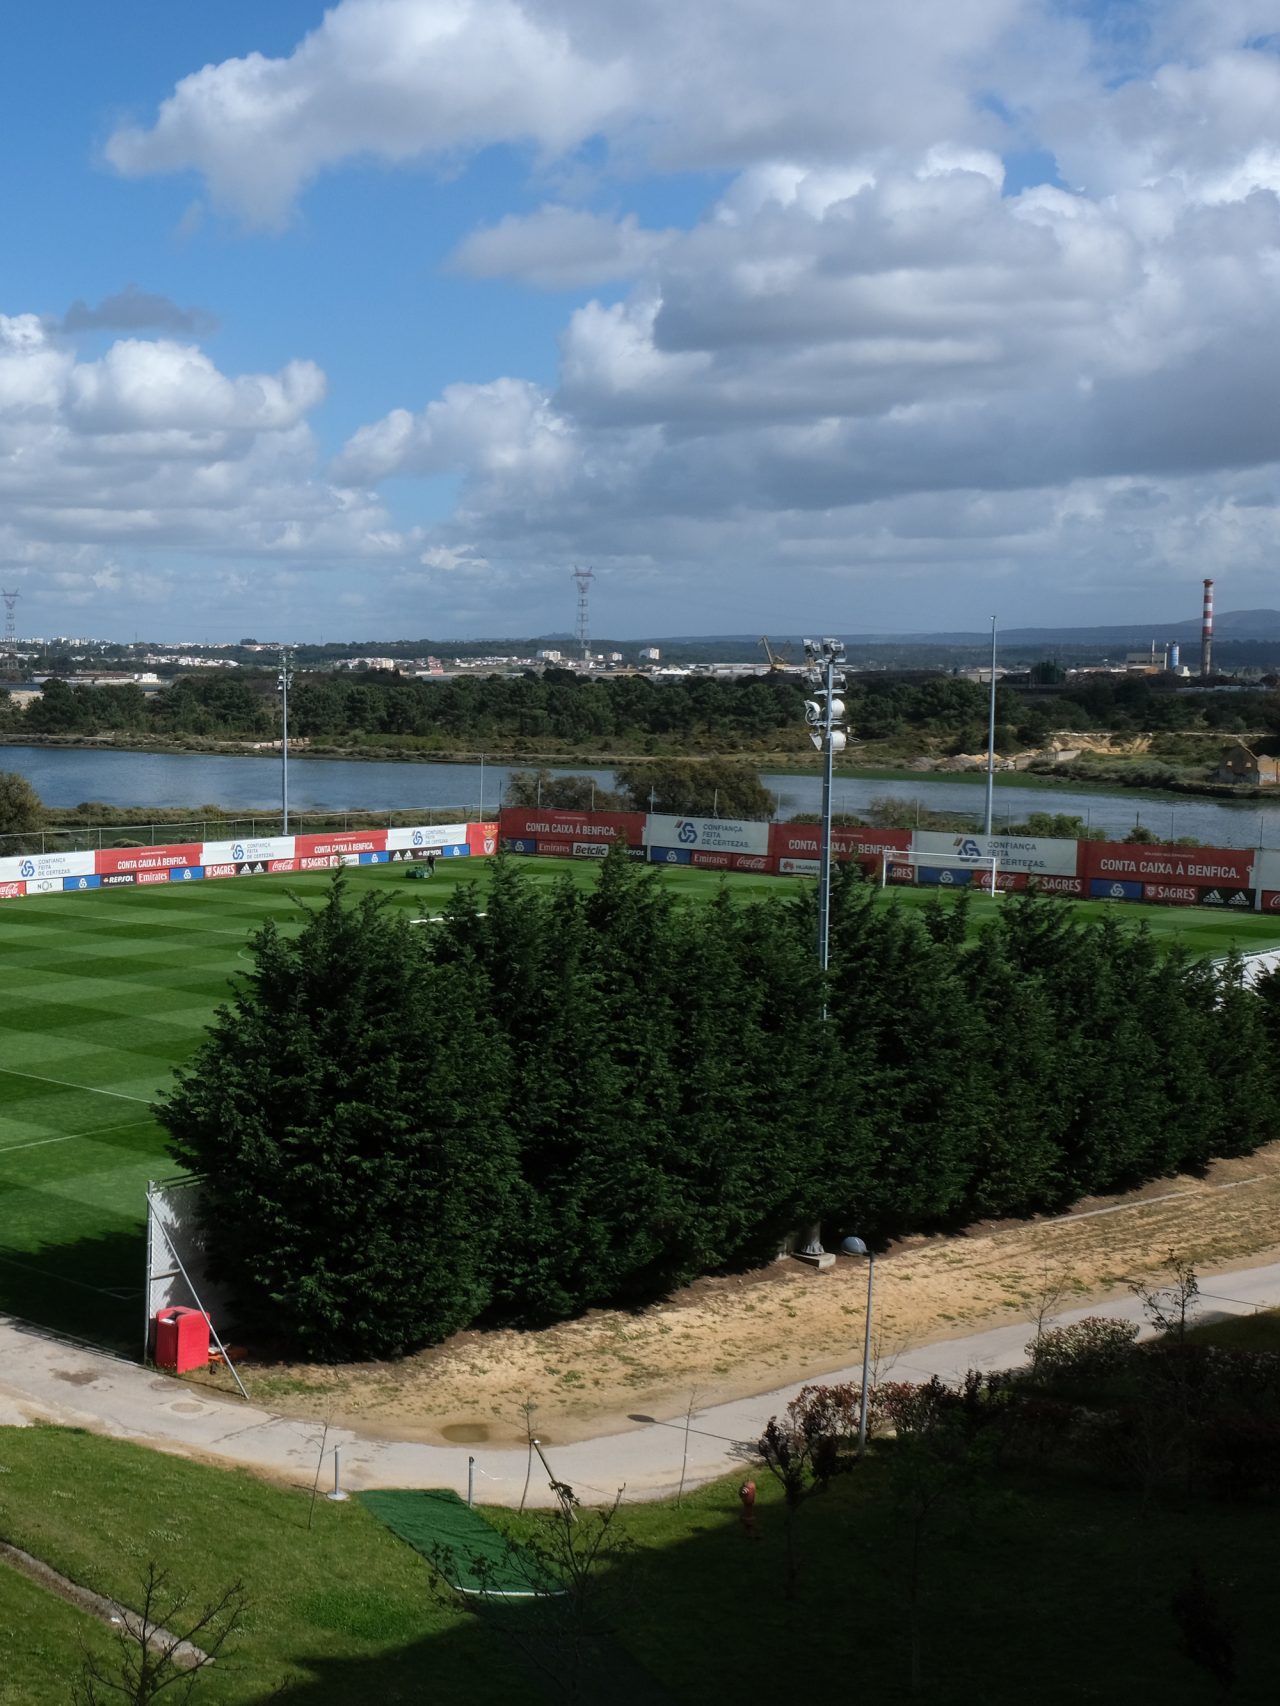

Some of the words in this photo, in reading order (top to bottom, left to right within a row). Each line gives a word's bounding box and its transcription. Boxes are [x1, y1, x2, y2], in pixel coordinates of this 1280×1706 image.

[526, 822, 550, 833] CONTA
[551, 823, 574, 834] CAIXA
[575, 822, 581, 835] À
[703, 823, 743, 833] CONFIANÇA
[314, 845, 331, 854] CONTA
[332, 844, 348, 853] CAIXA
[348, 842, 352, 851] À
[539, 842, 570, 853] Emirates
[702, 838, 712, 846] DE
[788, 839, 818, 851] CONTA
[987, 841, 1037, 851] CONFIANÇA
[575, 845, 607, 856] Betclic
[987, 849, 1009, 857] FEITA
[117, 860, 137, 869] CONTA
[138, 859, 156, 868] CAIXA
[157, 857, 162, 867] À
[307, 856, 328, 868] SAGRES
[694, 853, 728, 865] Emirates
[212, 864, 235, 876] SAGRES
[891, 867, 913, 879] GRES
[1100, 859, 1137, 872] CONTA
[1140, 861, 1173, 875] CAIXA
[1176, 861, 1185, 875] À
[1187, 864, 1240, 879] BENFICA.
[109, 875, 134, 883] REPSOL
[138, 871, 167, 882] Emirates
[37, 880, 53, 890] NOS
[1042, 878, 1081, 892] SAGRES
[1158, 886, 1196, 900] SAGRES
[1227, 898, 1250, 906] adidas
